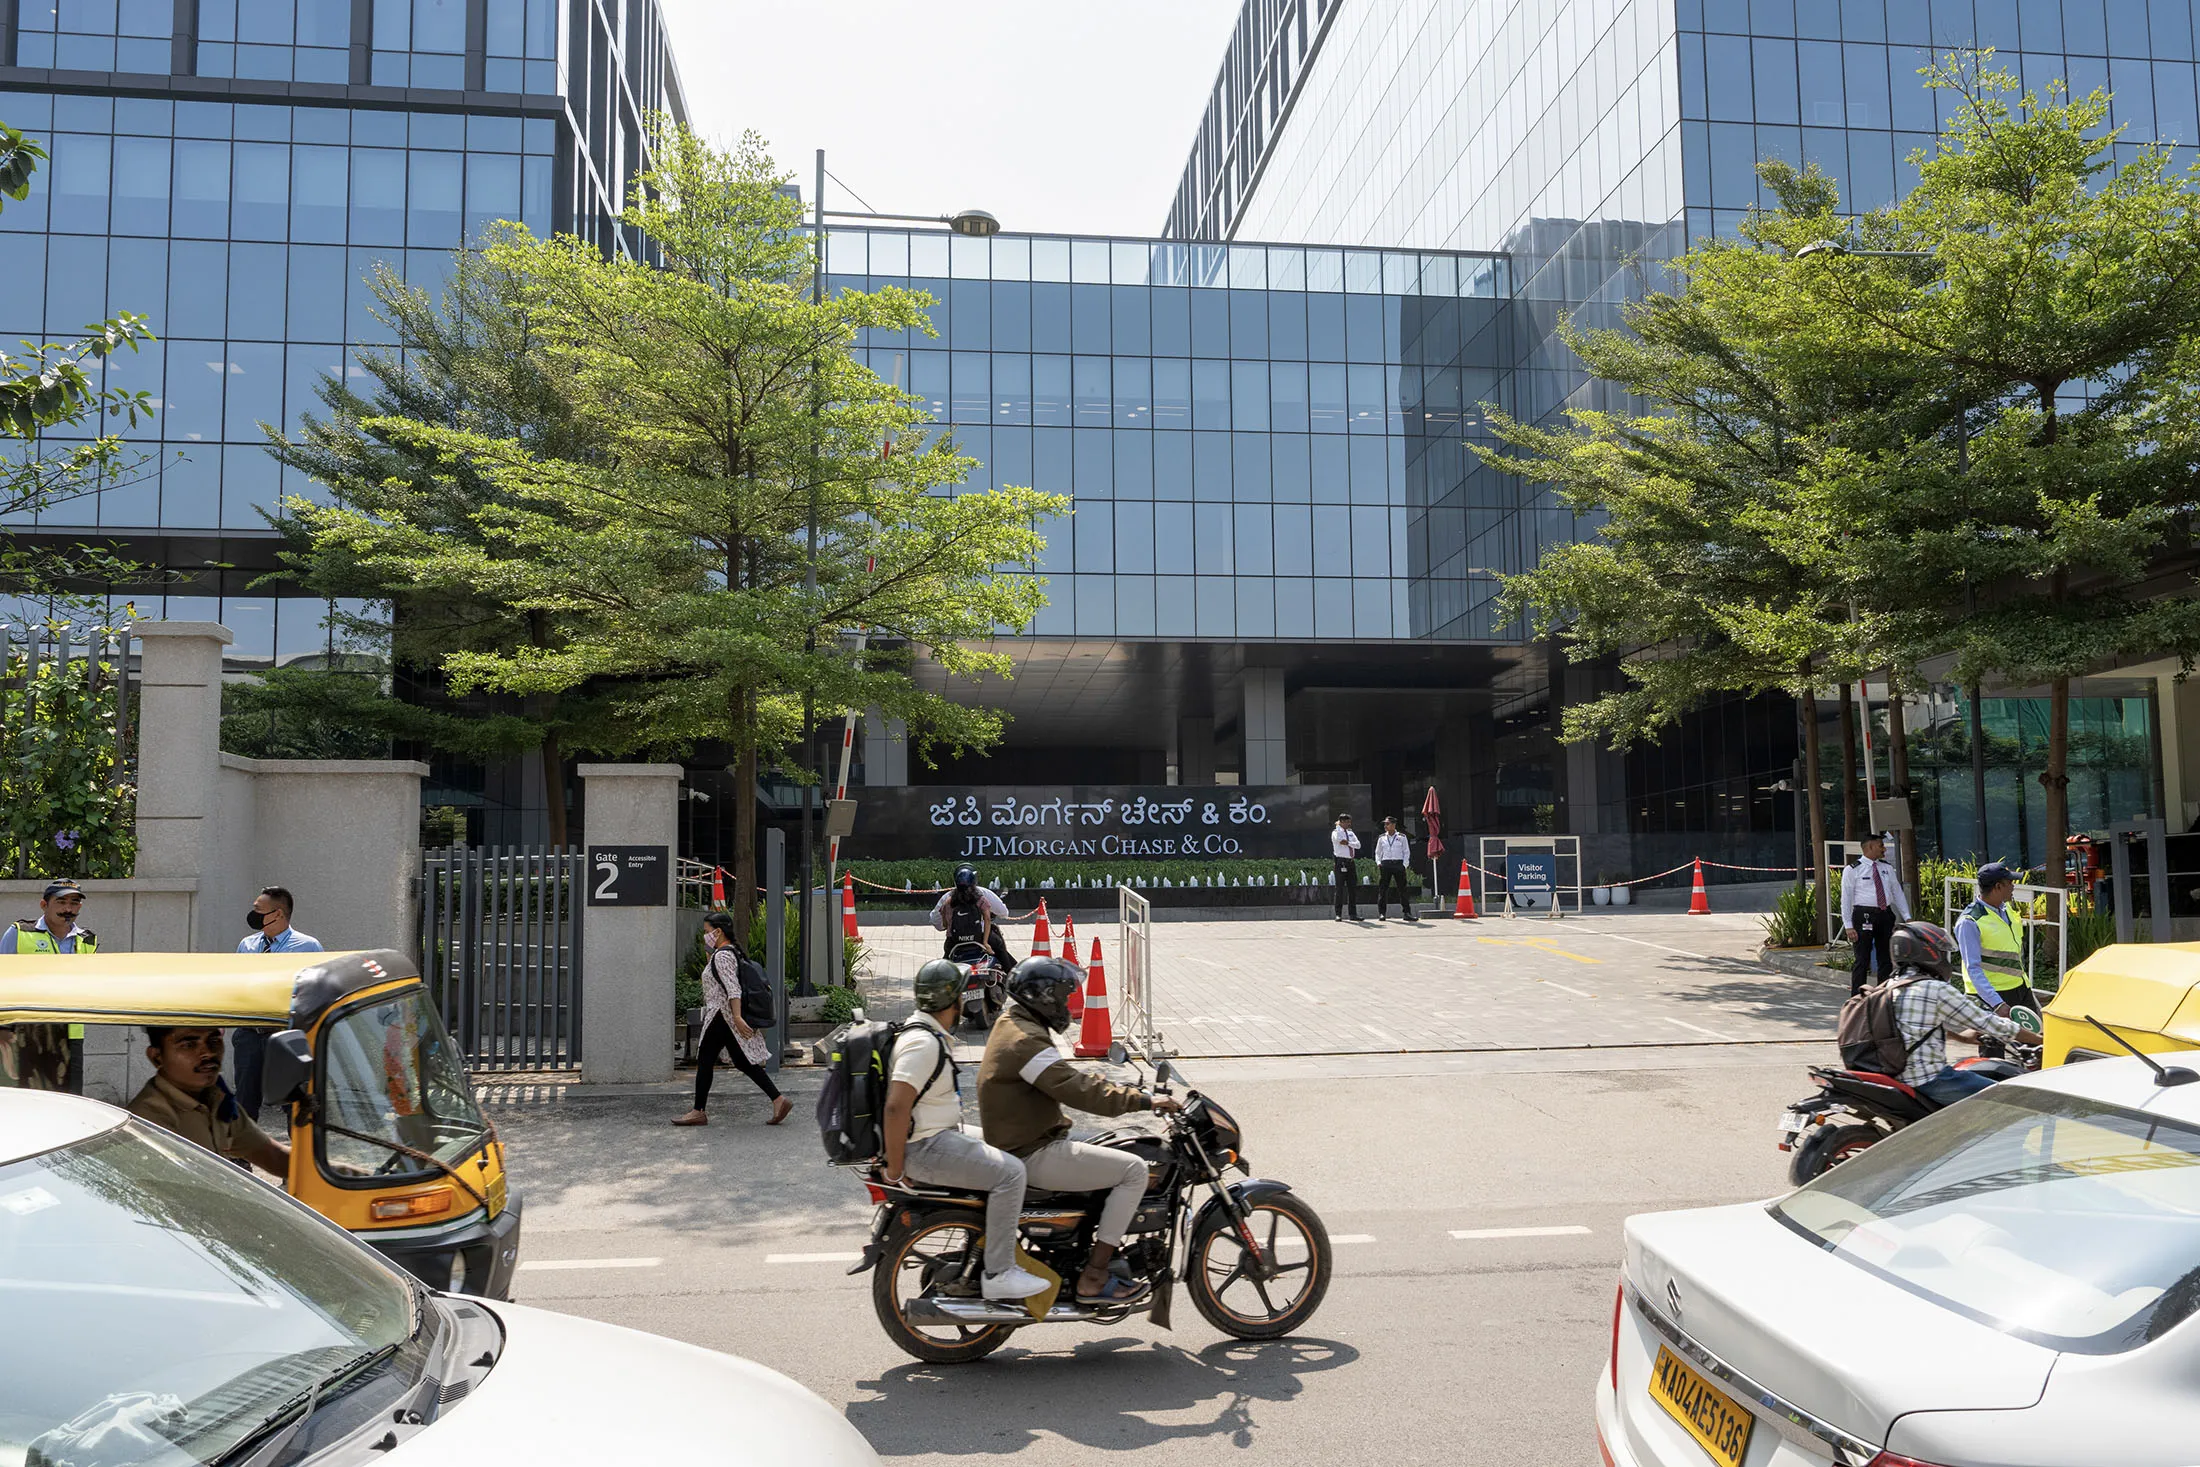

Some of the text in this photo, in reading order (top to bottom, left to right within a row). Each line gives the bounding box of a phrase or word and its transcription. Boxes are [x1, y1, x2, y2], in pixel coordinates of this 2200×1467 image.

[929, 795, 982, 826] ಜೆಪಿ
[1120, 796, 1194, 825] ಚೇಸ್
[1201, 802, 1220, 825] &
[1181, 834, 1200, 854] &
[595, 853, 618, 862] Gate
[595, 862, 619, 899] 2
[1517, 872, 1547, 881] Parking
[2018, 1010, 2034, 1031] GO
[1659, 1356, 1743, 1462] KA04AE5136
